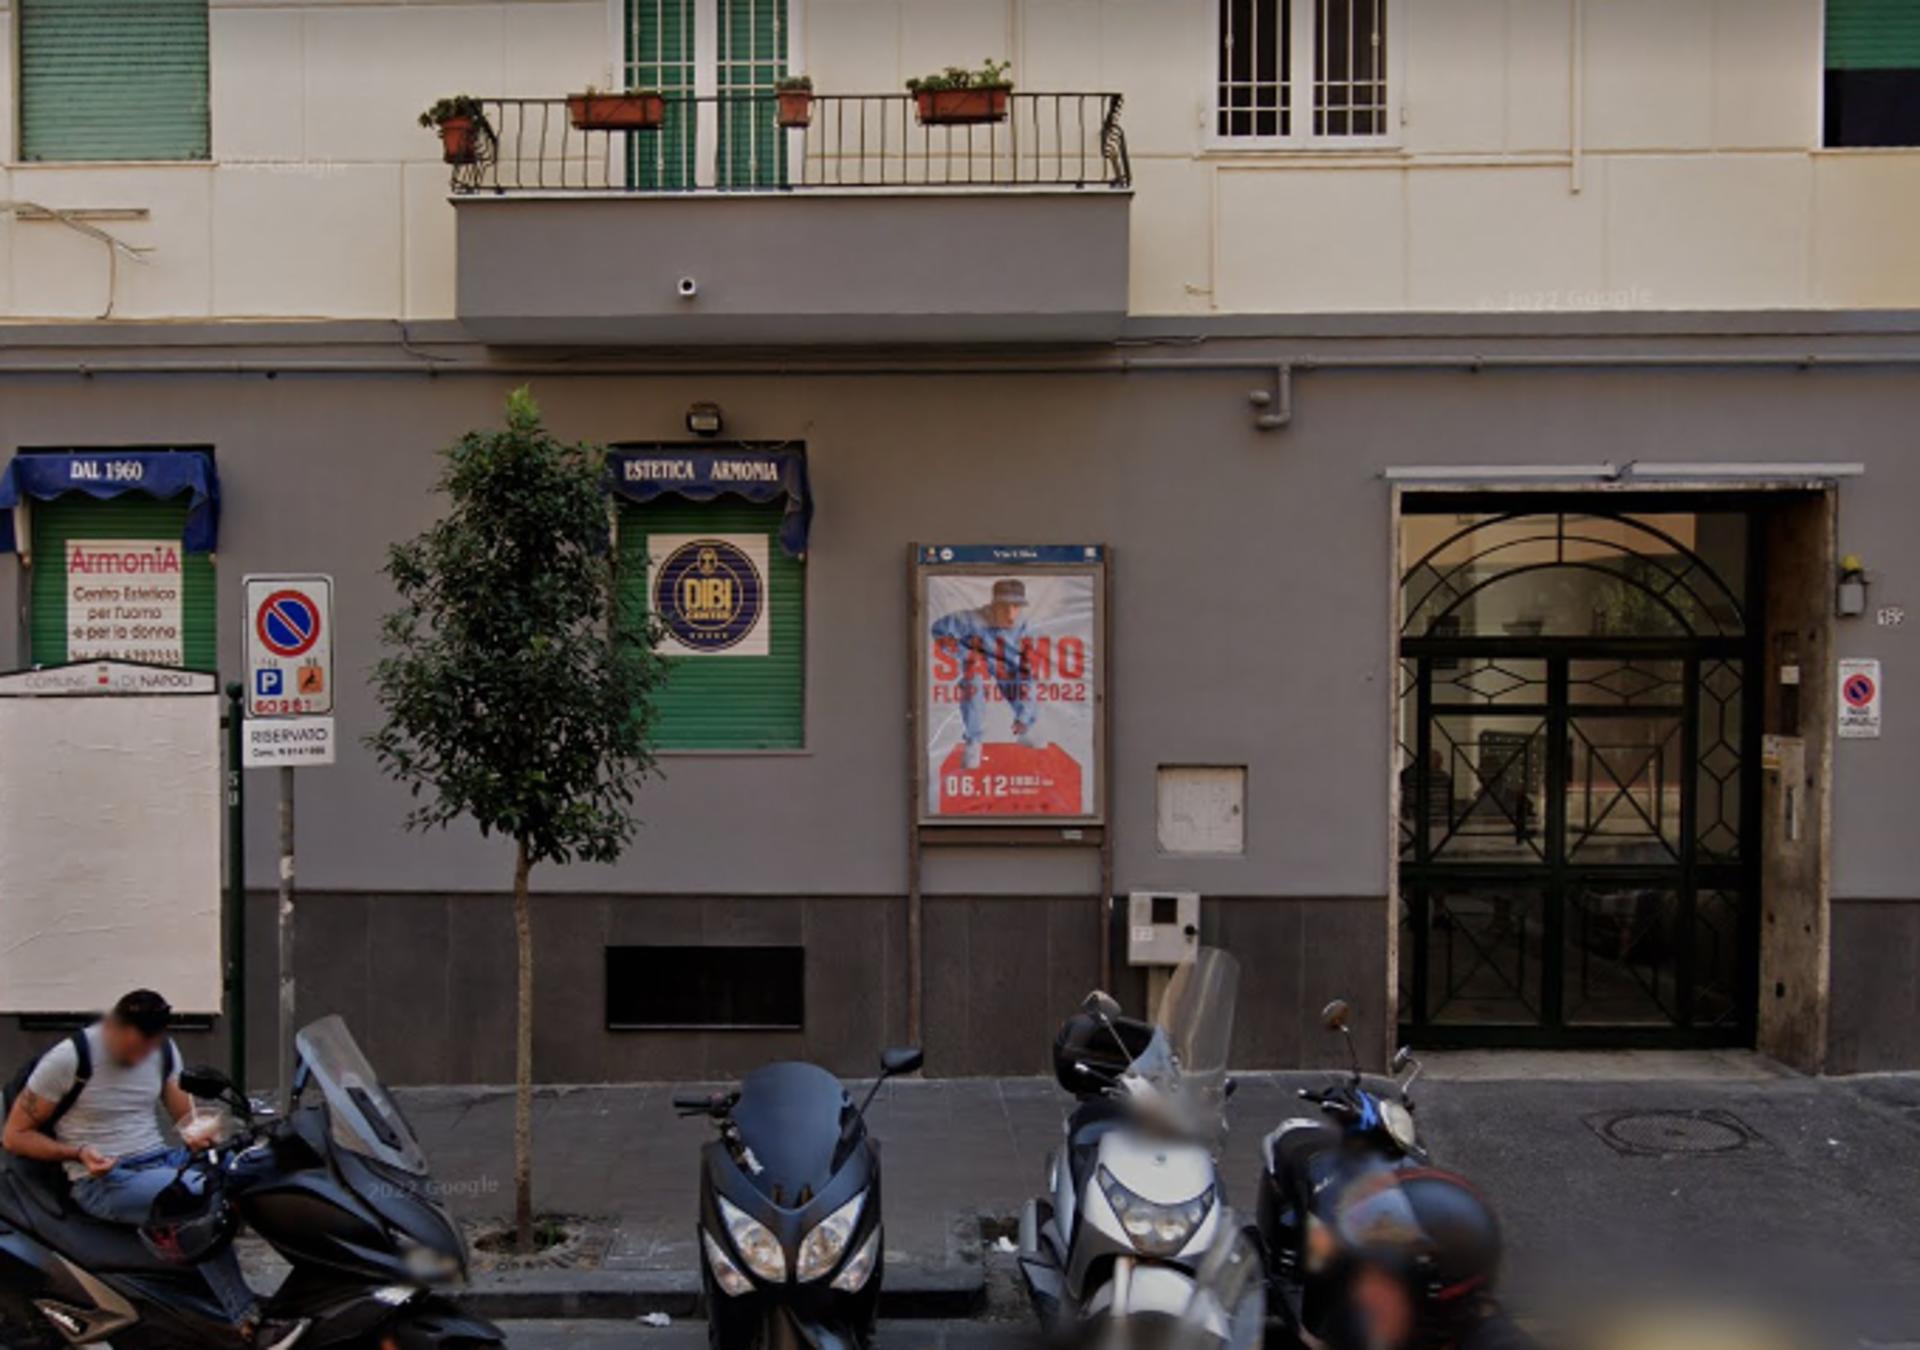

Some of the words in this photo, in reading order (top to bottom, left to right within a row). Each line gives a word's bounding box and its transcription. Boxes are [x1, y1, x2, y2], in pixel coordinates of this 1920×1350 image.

[70, 460, 100, 479] DAL
[105, 461, 143, 480] 1960
[624, 460, 696, 481] ESTETICA
[710, 462, 779, 481] ARMONIA
[70, 546, 179, 574] ArmoniA
[73, 587, 119, 602] Centro
[124, 586, 176, 601] Estetica
[684, 578, 732, 609] DIBI
[87, 608, 111, 621] per
[87, 626, 111, 641] per
[131, 624, 176, 639] donna
[932, 636, 1085, 681] SALMO
[25, 675, 88, 688] COMUNE
[140, 675, 193, 688] NAPOLI
[932, 683, 979, 704] FLOP
[983, 683, 1030, 704] TOUR
[1037, 683, 1086, 703] 2022
[251, 728, 328, 744] RISERVATO
[946, 775, 1008, 797] 06.12
